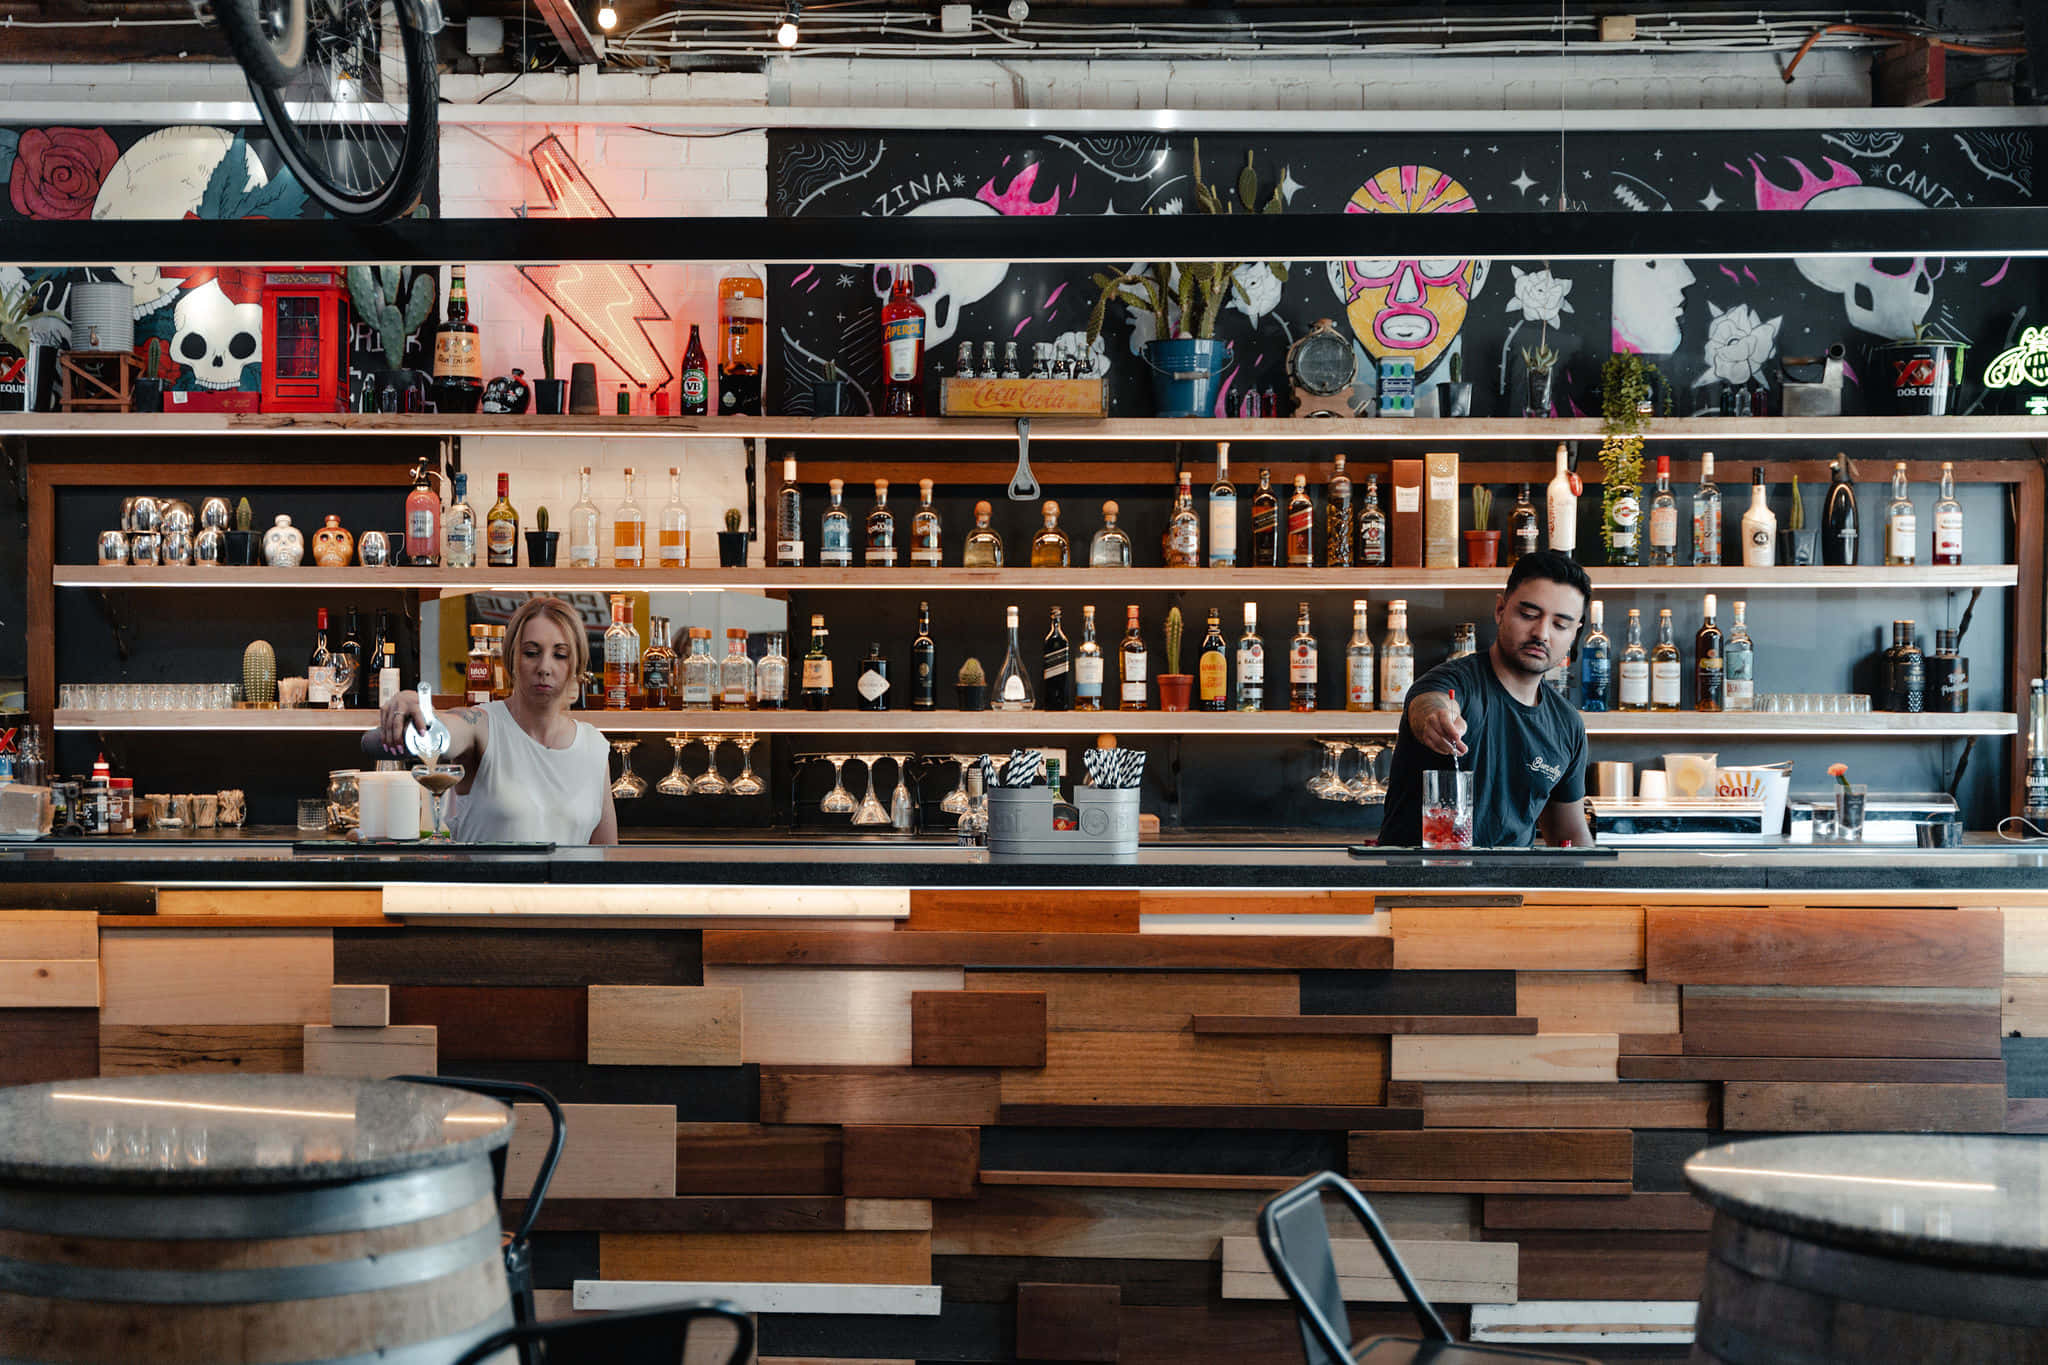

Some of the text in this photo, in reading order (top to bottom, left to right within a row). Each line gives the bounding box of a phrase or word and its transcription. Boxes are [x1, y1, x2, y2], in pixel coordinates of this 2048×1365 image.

[861, 171, 951, 216] ZINA
[884, 323, 921, 341] APEROL
[687, 382, 701, 392] VB
